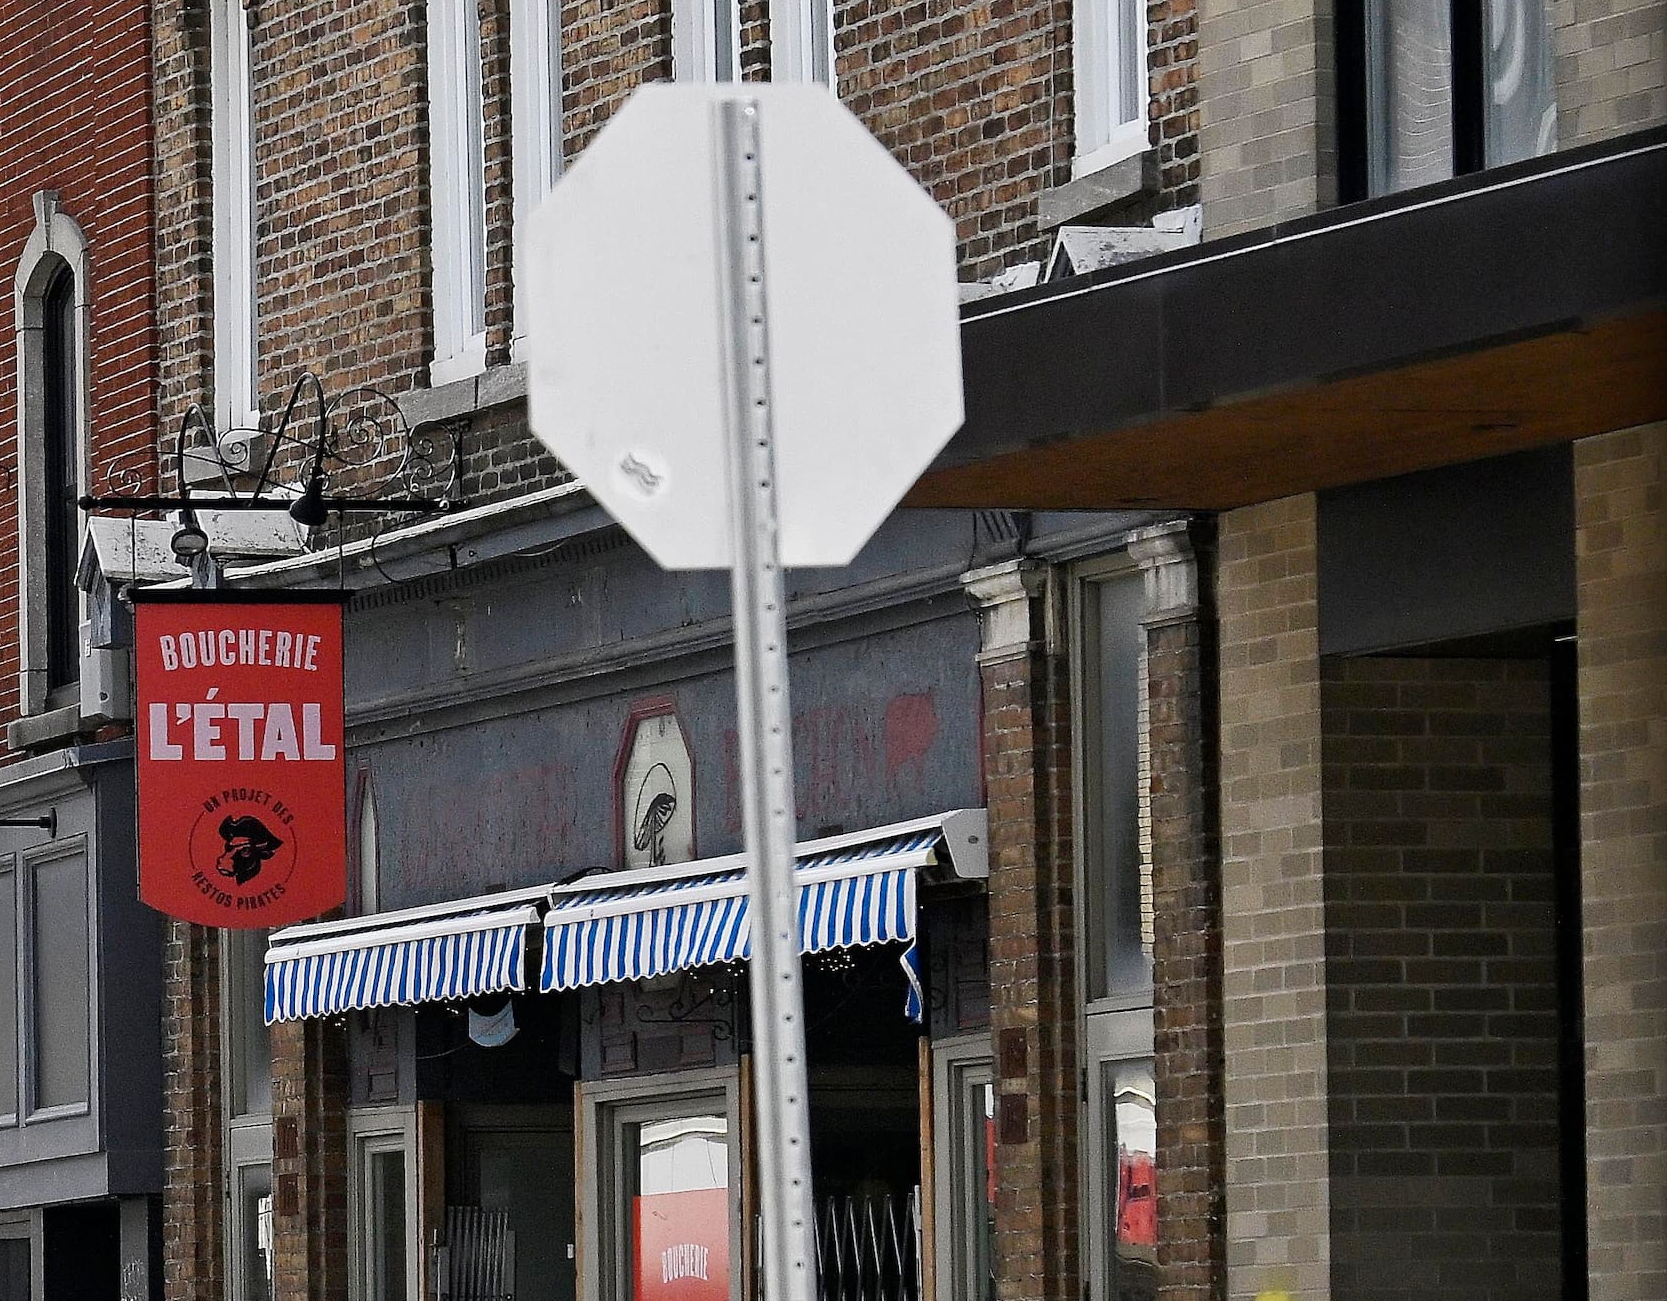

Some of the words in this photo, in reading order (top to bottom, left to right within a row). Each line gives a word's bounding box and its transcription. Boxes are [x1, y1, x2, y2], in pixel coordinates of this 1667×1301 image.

[159, 629, 321, 672] BOUCHERIE
[149, 687, 336, 761] L'ÉTAL
[203, 795, 220, 813] UN
[222, 788, 272, 806] PROJET
[272, 801, 294, 825] DES
[191, 870, 232, 908] RESTOS
[236, 883, 286, 910] PIRATES
[661, 1243, 709, 1284] BOUCHERIE
